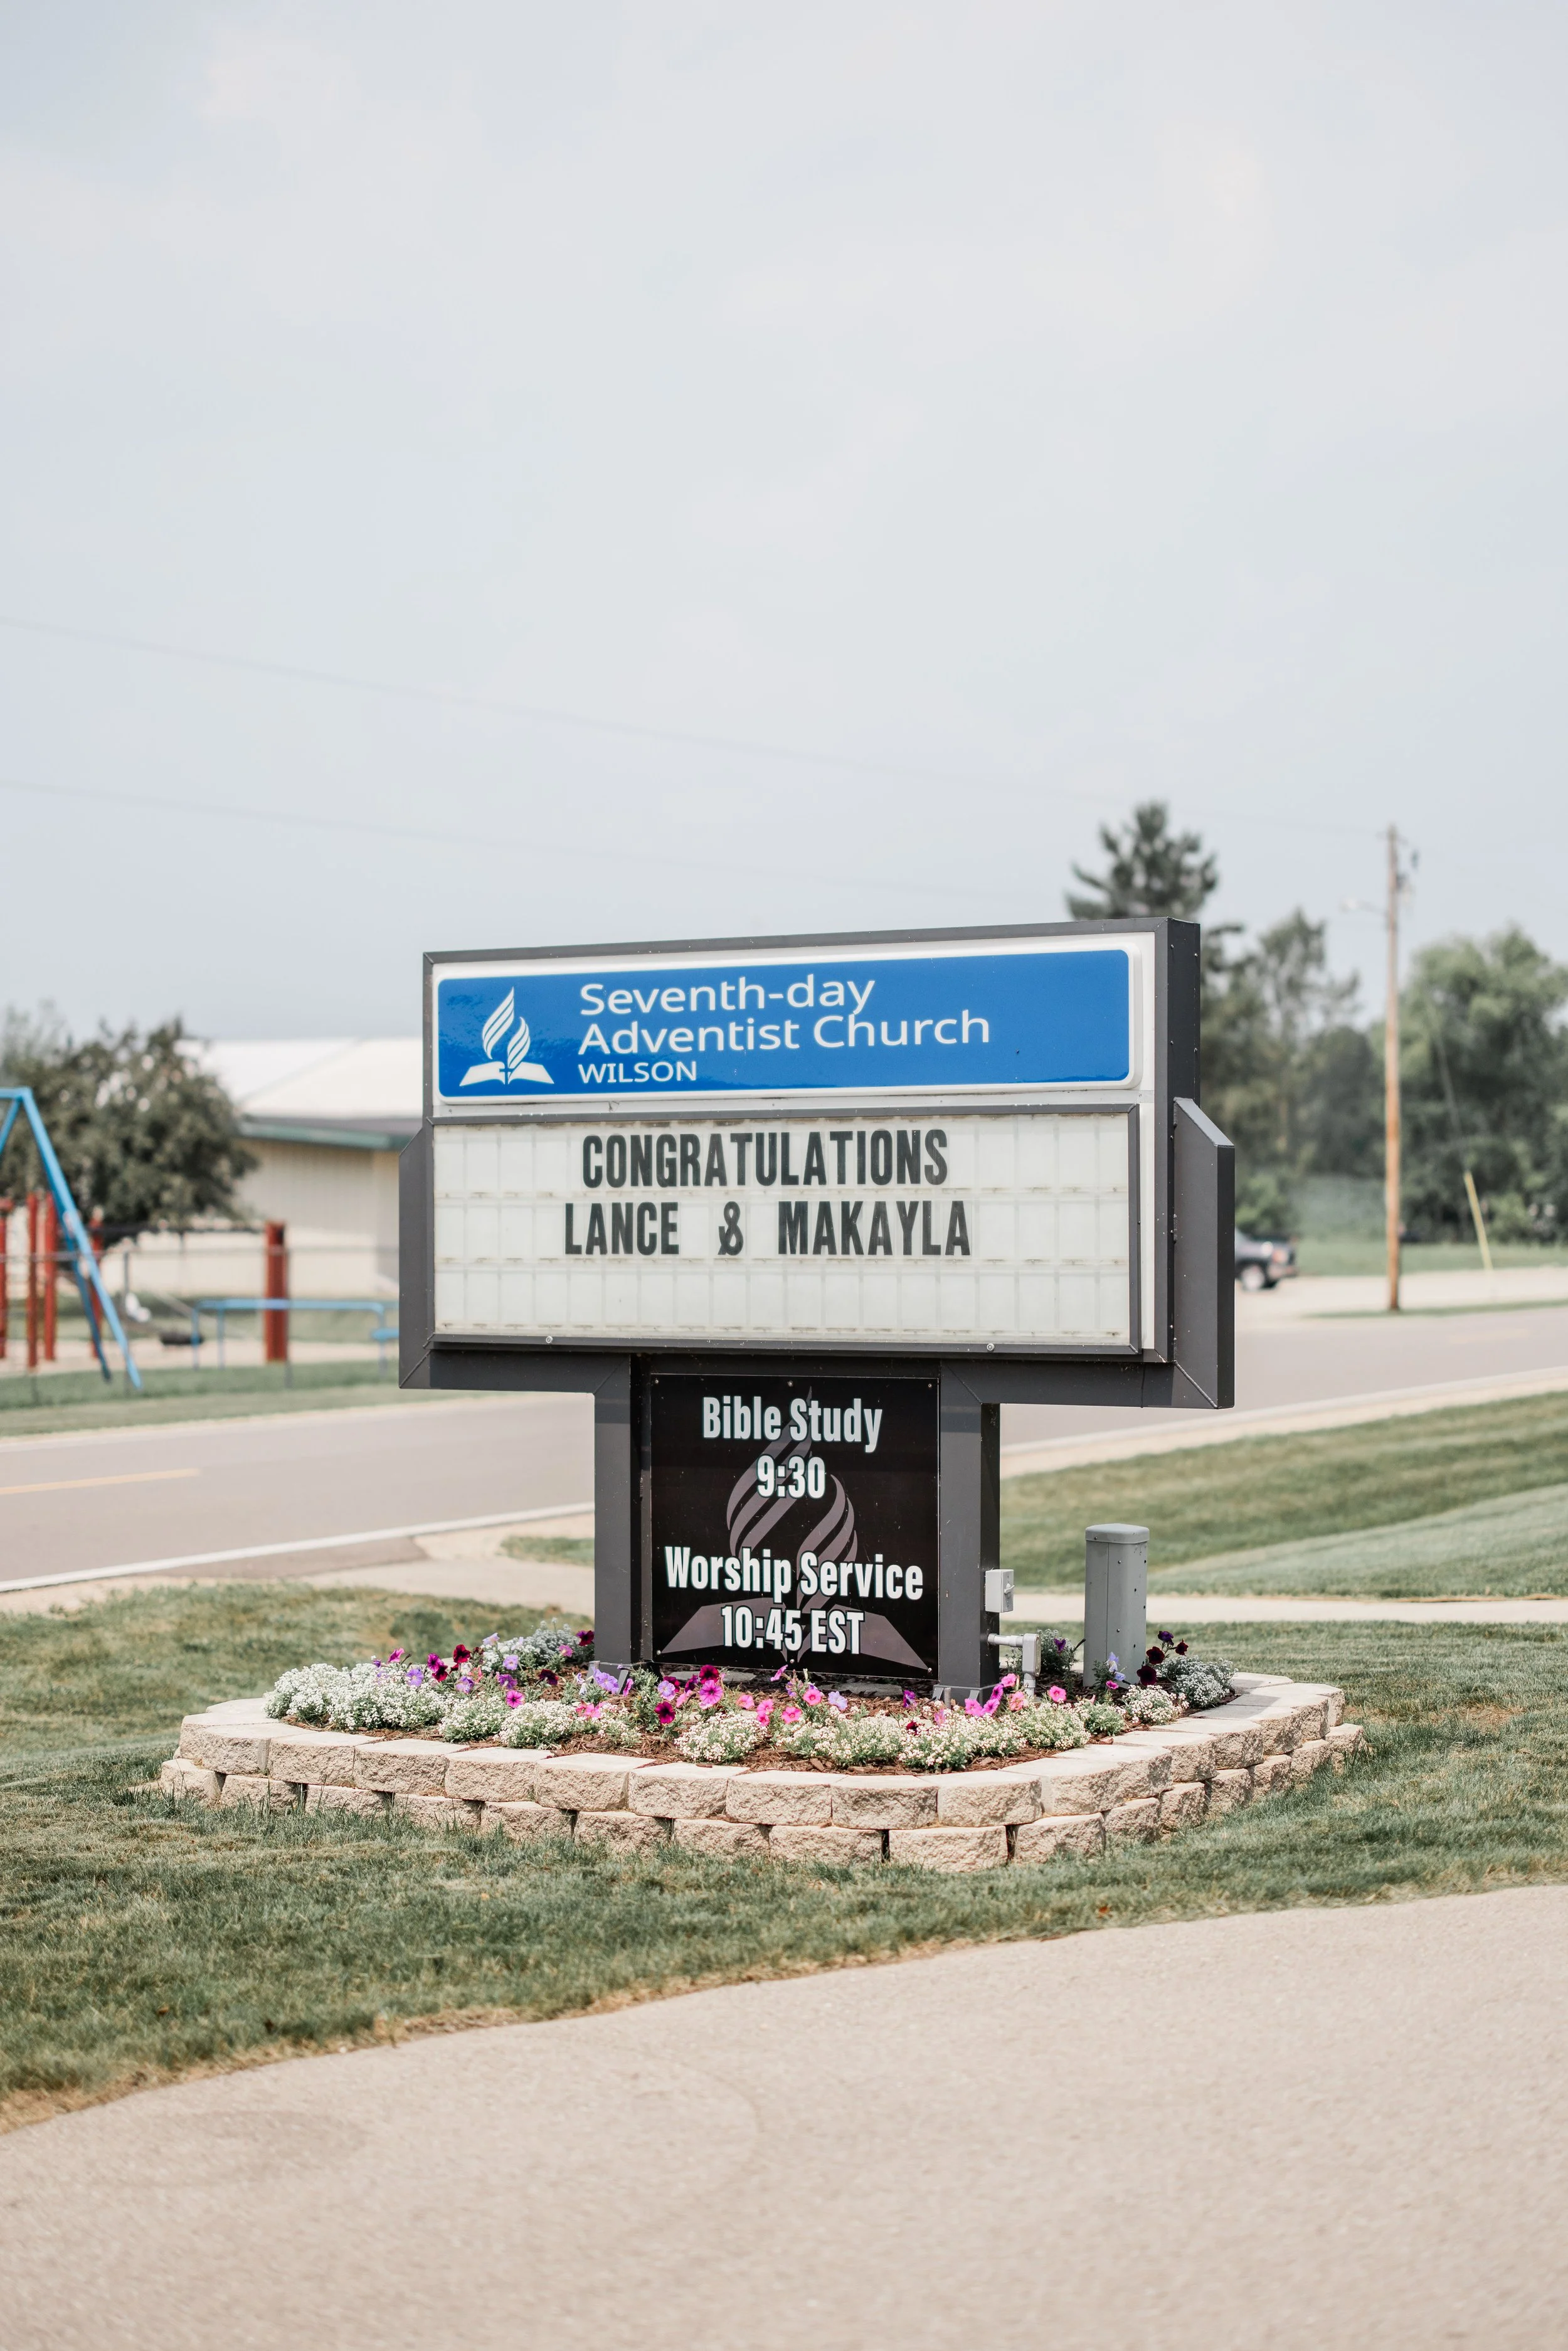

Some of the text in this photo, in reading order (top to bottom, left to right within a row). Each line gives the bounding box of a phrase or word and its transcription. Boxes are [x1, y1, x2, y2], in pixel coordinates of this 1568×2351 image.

[580, 974, 876, 1016] Seventh-day
[578, 1009, 990, 1055] Adventist Church
[578, 1061, 697, 1083] WILSON
[582, 1129, 948, 1188] CONGRATULATIONS
[564, 1201, 971, 1256] LANCE & MAKAYLA
[703, 1396, 883, 1453] Bible Study
[757, 1455, 825, 1499] 9:30
[664, 1546, 924, 1604] Worship Service
[721, 1605, 865, 1655] 10:45 EST
